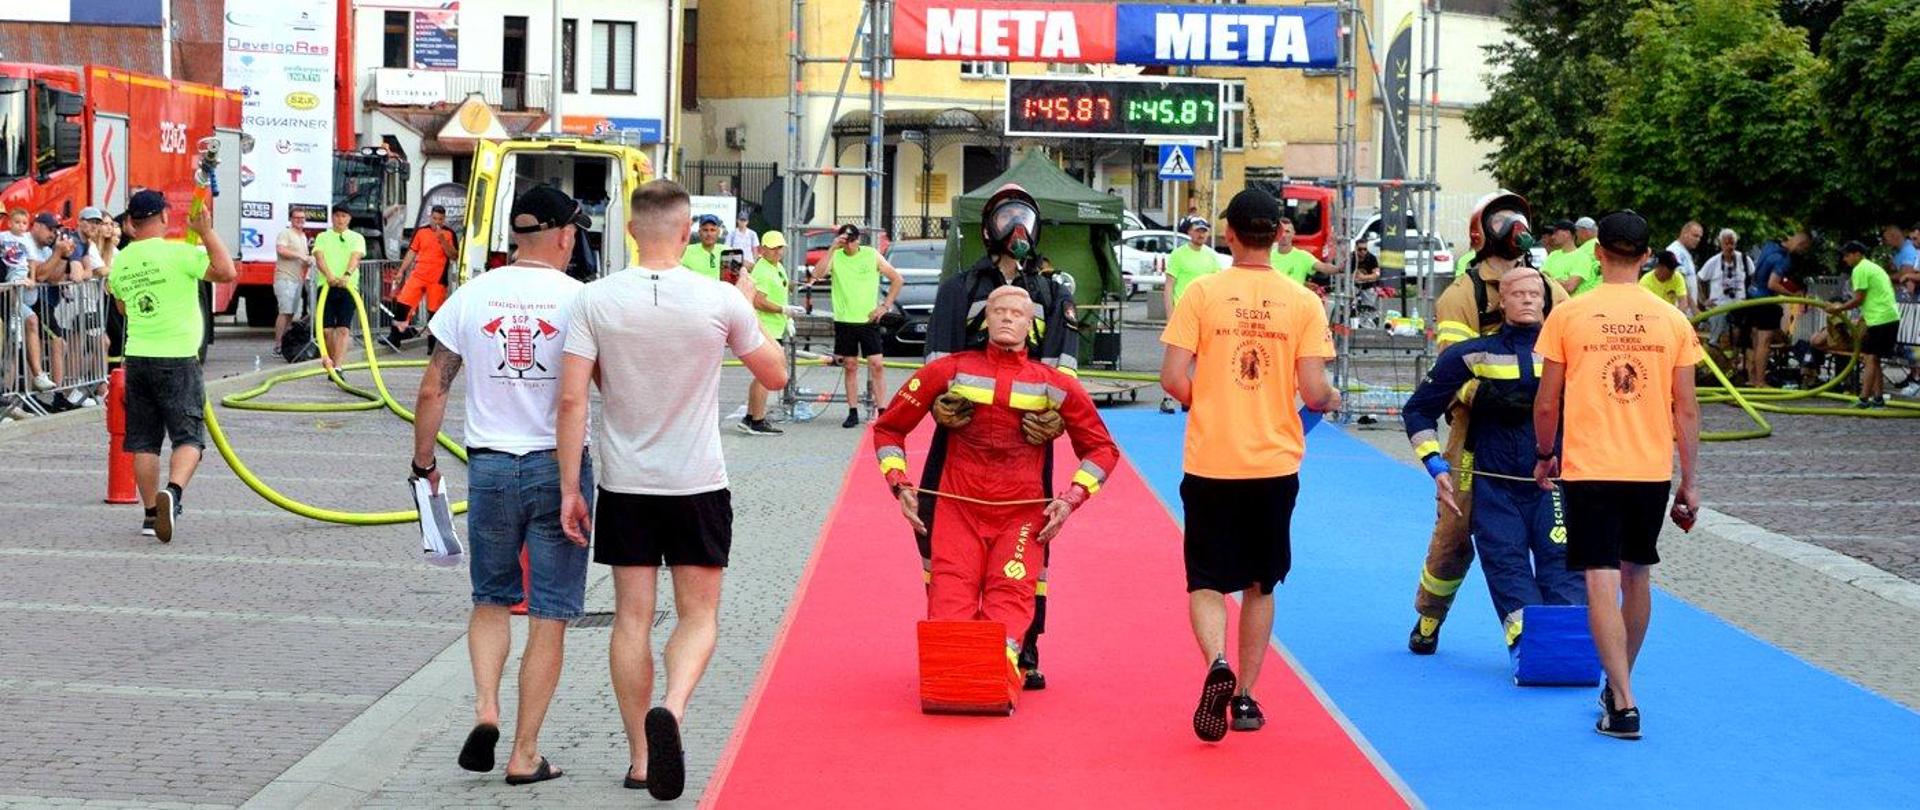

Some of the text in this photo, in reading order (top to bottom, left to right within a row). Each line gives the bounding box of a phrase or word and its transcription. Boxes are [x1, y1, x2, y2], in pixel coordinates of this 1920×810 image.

[926, 8, 1080, 58] META
[1155, 13, 1310, 63] META
[228, 37, 329, 54] DevelopRes
[1023, 98, 1111, 122] 1:45.87
[1129, 100, 1215, 124] 1:45.87
[512, 315, 530, 324] SGP
[1601, 323, 1647, 336] SĘDZIA
